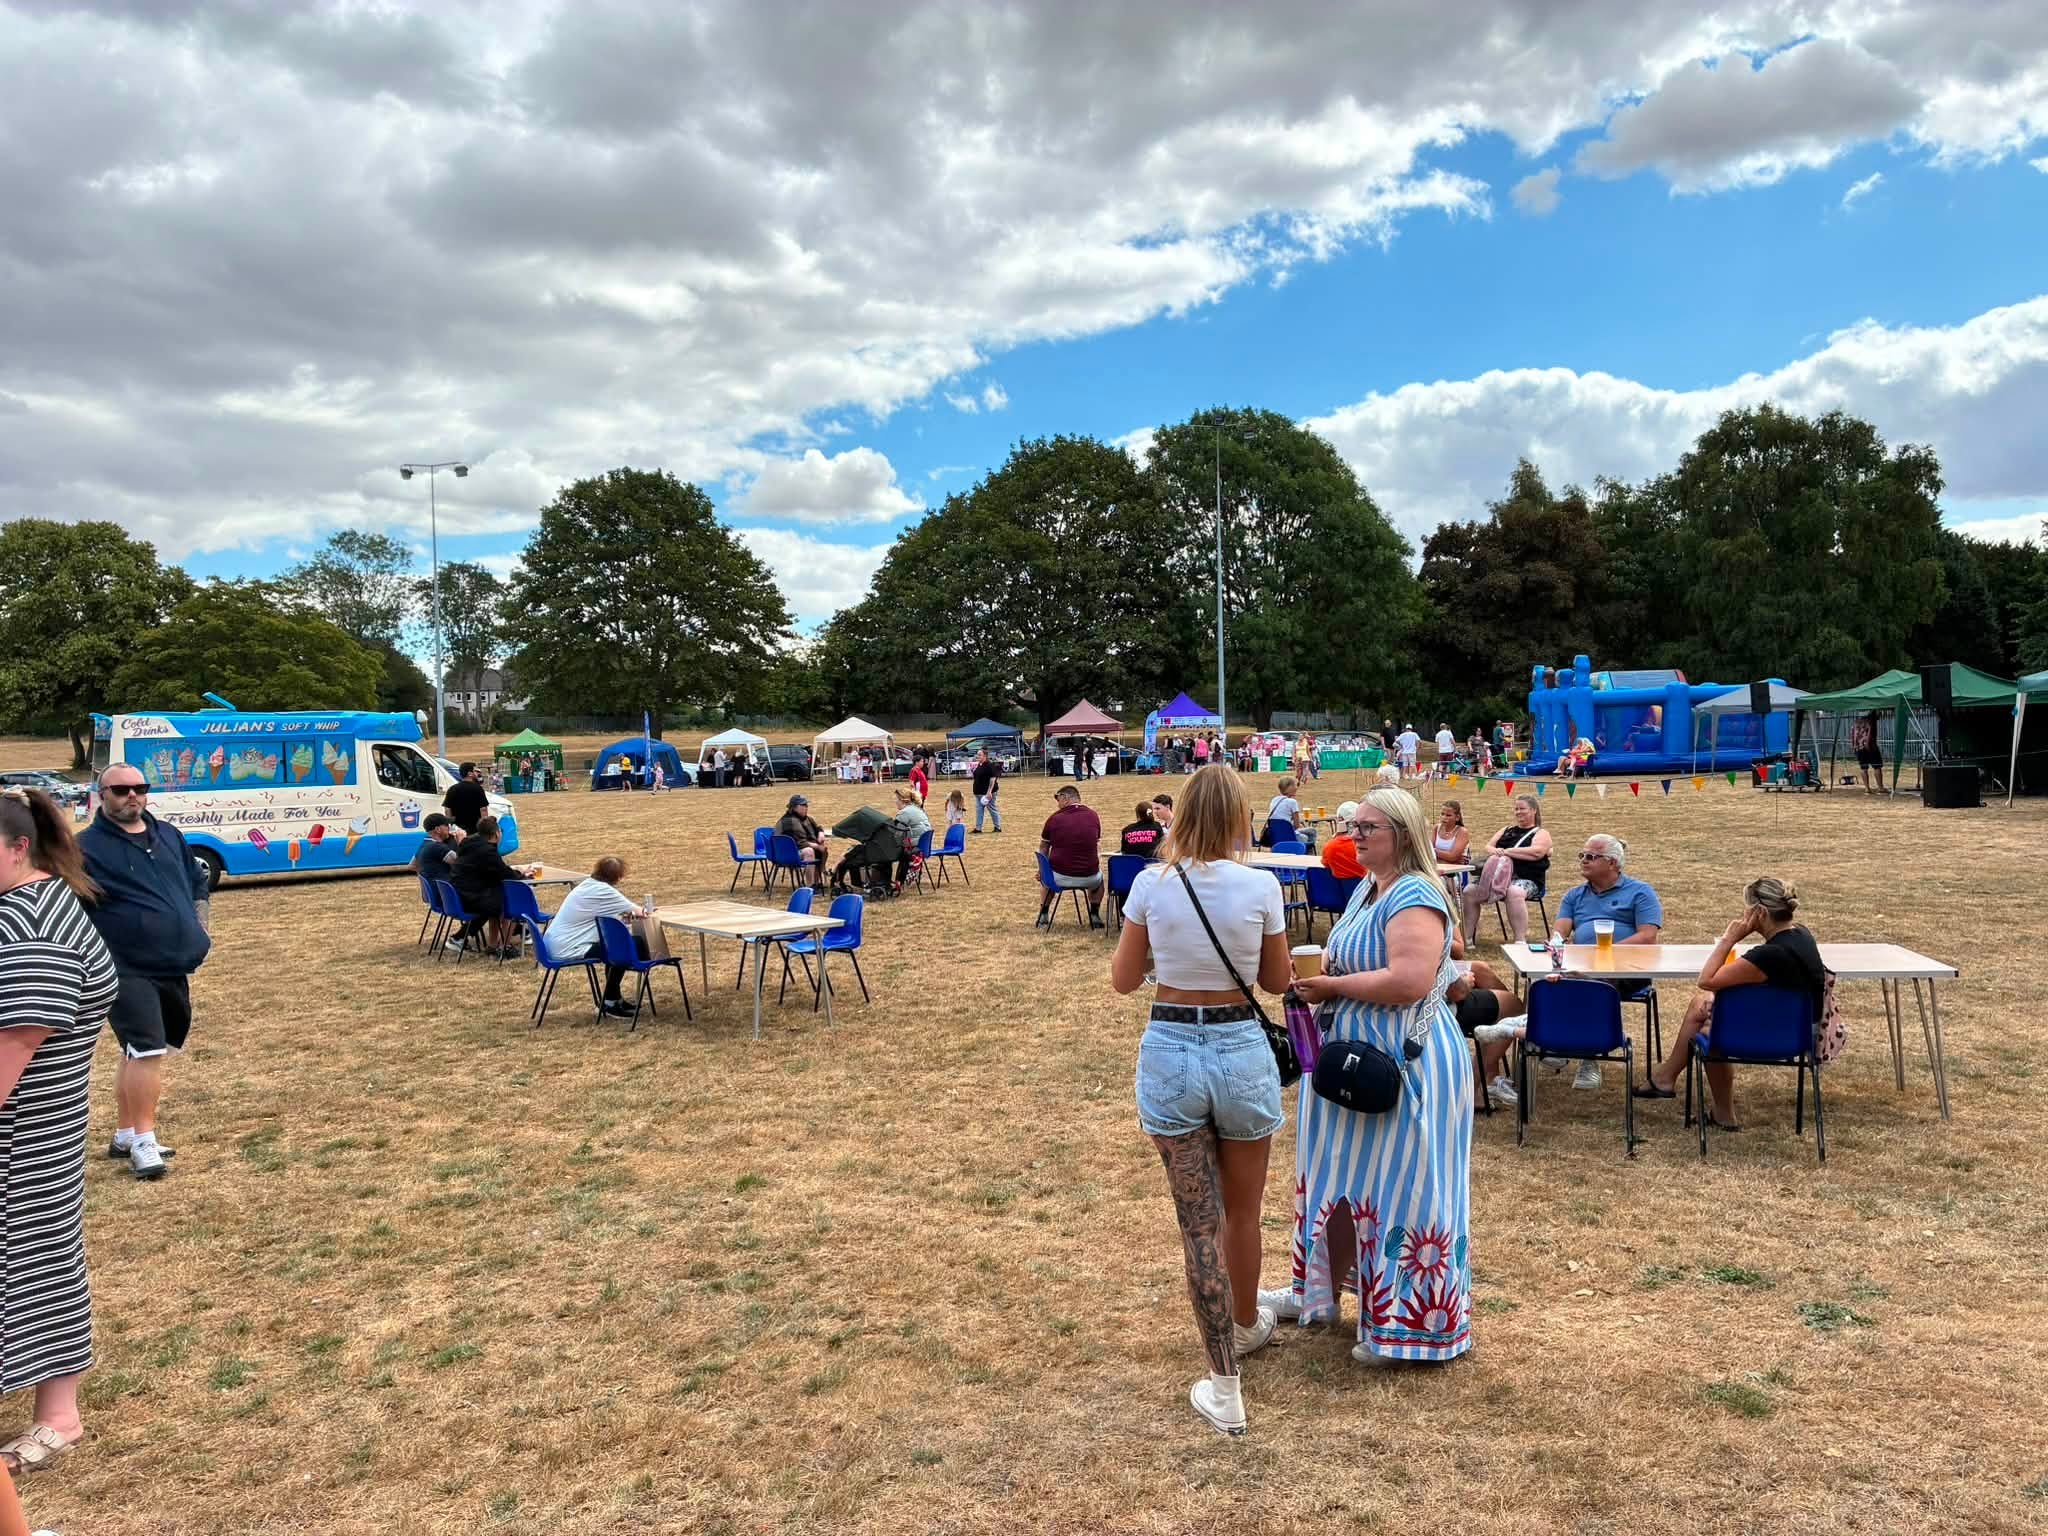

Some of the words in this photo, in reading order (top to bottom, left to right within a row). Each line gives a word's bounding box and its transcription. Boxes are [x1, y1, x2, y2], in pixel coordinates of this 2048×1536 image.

[121, 717, 150, 730] Cold
[200, 721, 276, 734] JULIAN'S
[281, 722, 311, 731] SOFT
[314, 720, 341, 730] WHIP
[132, 726, 169, 737] Drinks
[164, 811, 224, 826] Freshly
[228, 809, 275, 822] Made
[284, 807, 310, 819] For
[315, 806, 342, 817] You
